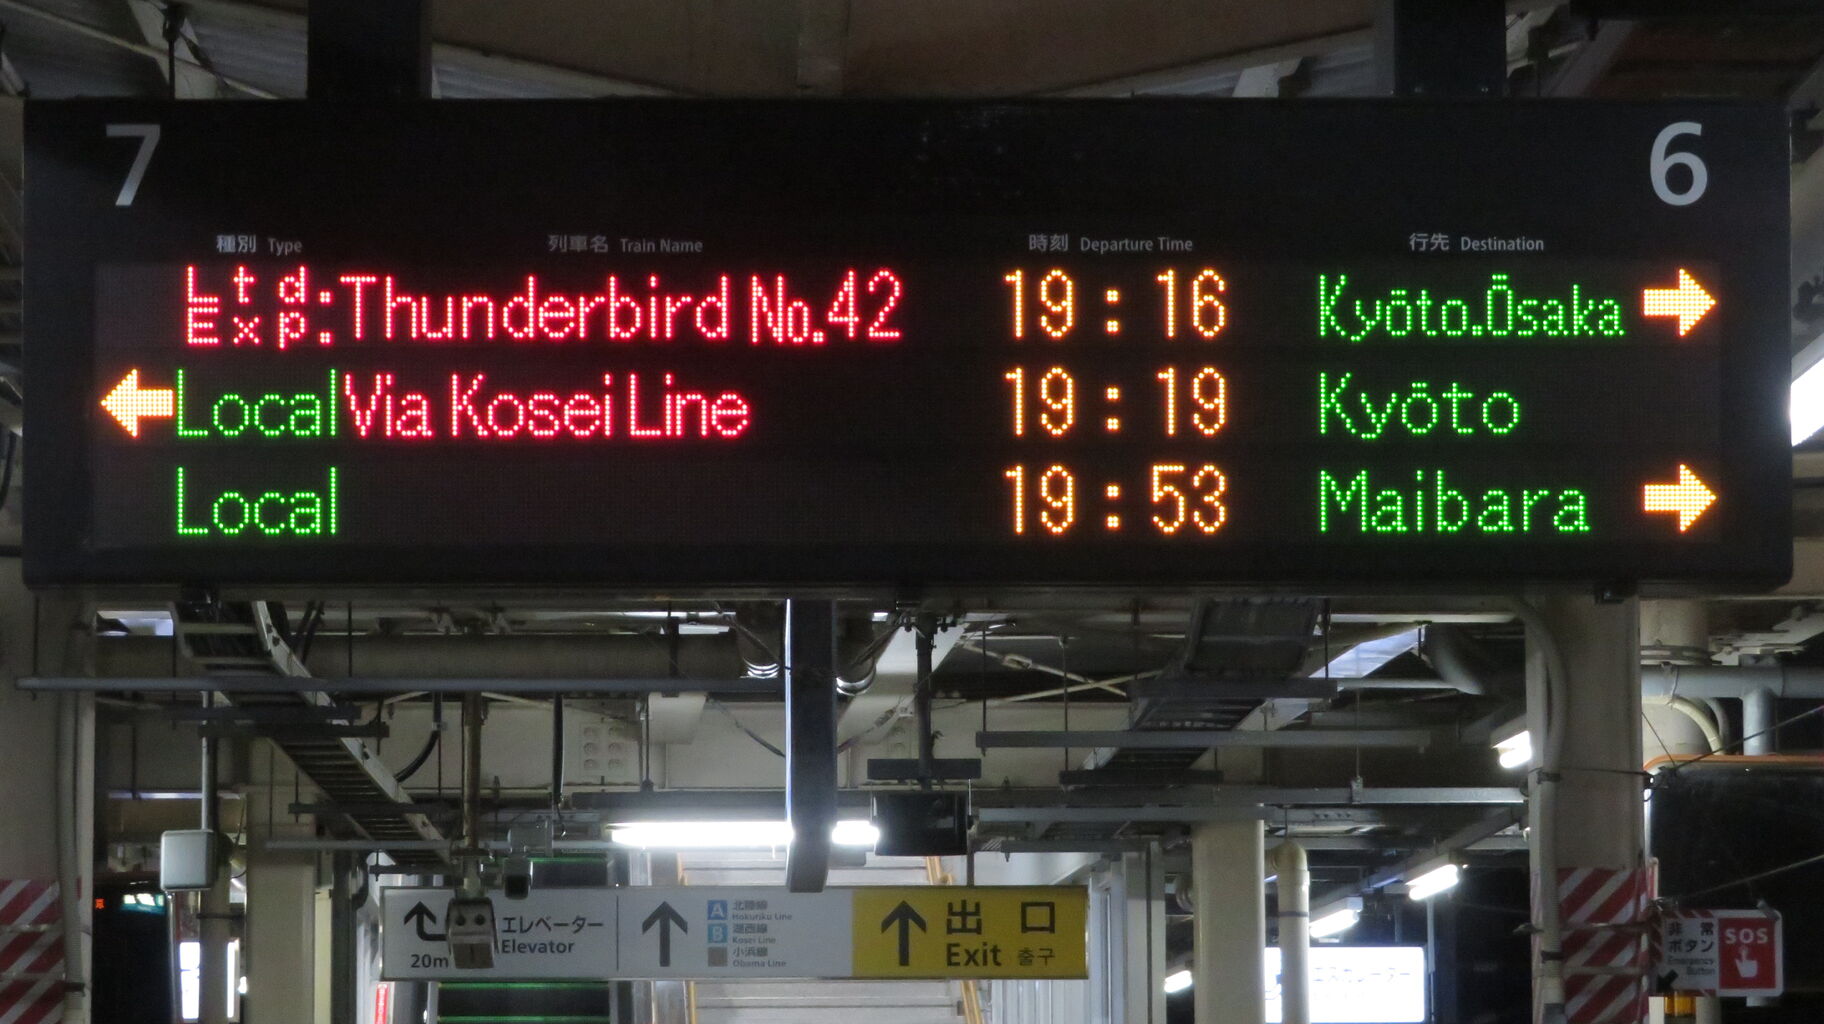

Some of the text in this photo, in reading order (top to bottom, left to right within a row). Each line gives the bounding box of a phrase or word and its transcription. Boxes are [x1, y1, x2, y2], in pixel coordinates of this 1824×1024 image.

[106, 123, 161, 207] 7
[1649, 121, 1708, 206] 6
[216, 234, 303, 256] 種別 Type
[548, 234, 703, 253] 列車名 Train Name
[1028, 233, 1193, 254] 時刻 Departure Time
[1409, 232, 1545, 252] 行先 Destination
[339, 273, 731, 341] Thunderbird
[175, 368, 337, 438] Local
[344, 373, 750, 439] Via Kosei Line
[1320, 372, 1519, 440] Kyōto
[175, 466, 337, 535] Local
[1320, 469, 1590, 533] Maibara
[502, 916, 604, 934] エレベーター
[946, 899, 1056, 935] 出口
[501, 939, 575, 954] Elevator
[1725, 928, 1769, 944] SOS
[946, 942, 1002, 967] Exit
[1018, 947, 1056, 967] 출구
